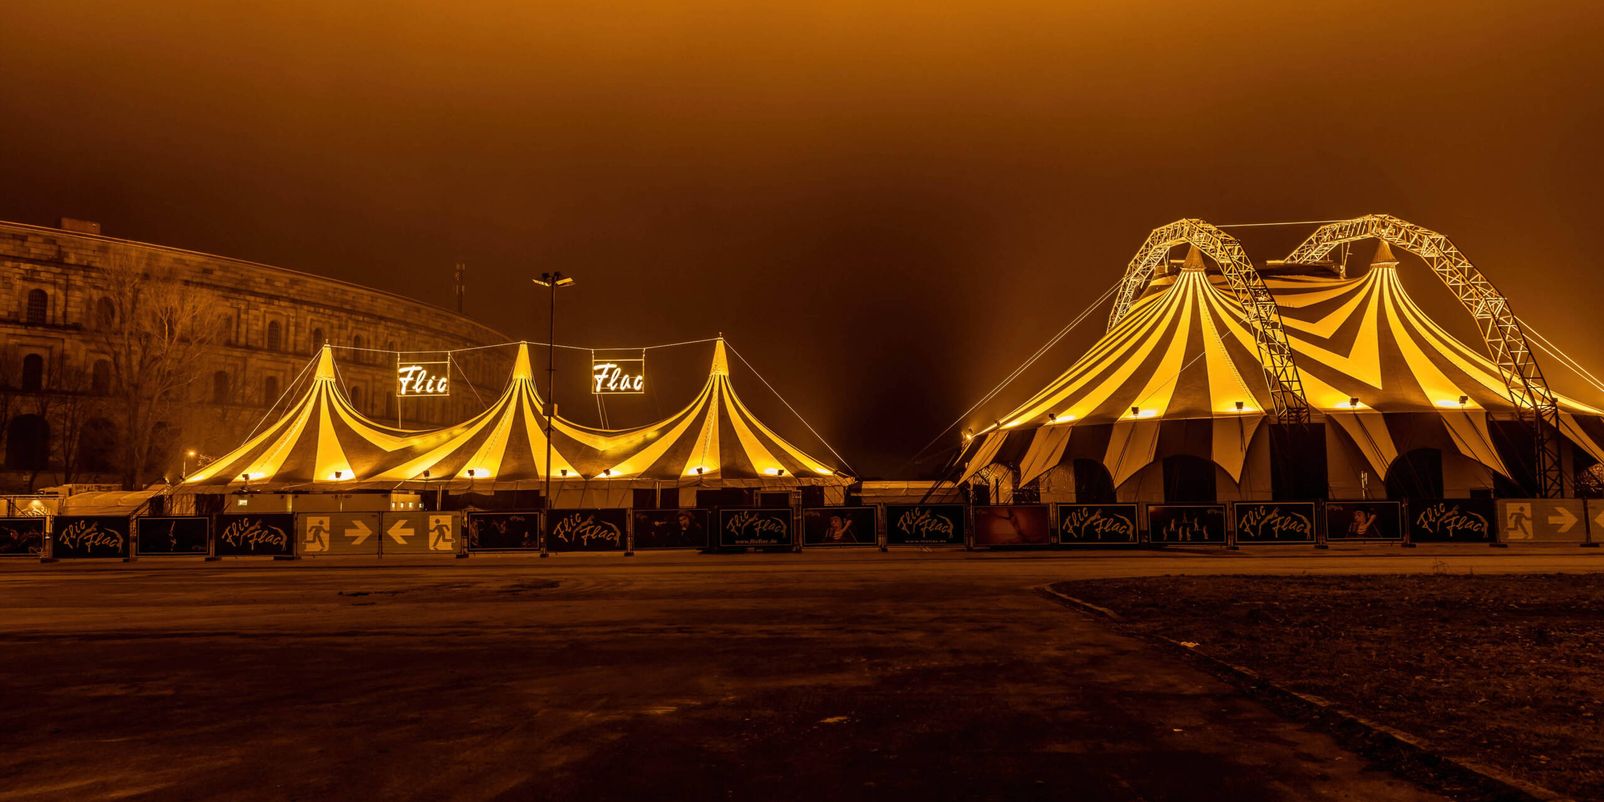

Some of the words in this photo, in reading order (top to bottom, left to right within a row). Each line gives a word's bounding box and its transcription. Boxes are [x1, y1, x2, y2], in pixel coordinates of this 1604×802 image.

[398, 364, 448, 395] Flic
[593, 362, 643, 393] Flac
[60, 518, 86, 549] Flic
[84, 528, 118, 552] Flac
[221, 517, 249, 547] Flic
[248, 529, 282, 551] Flac
[553, 513, 581, 542] Flic
[580, 525, 616, 547] Flac
[1062, 507, 1089, 538] Flic
[1093, 517, 1127, 539] Flac
[1238, 505, 1266, 537] Flic
[1271, 516, 1306, 538] Flac
[1416, 502, 1446, 533] Flic
[1447, 515, 1482, 538] Flac
